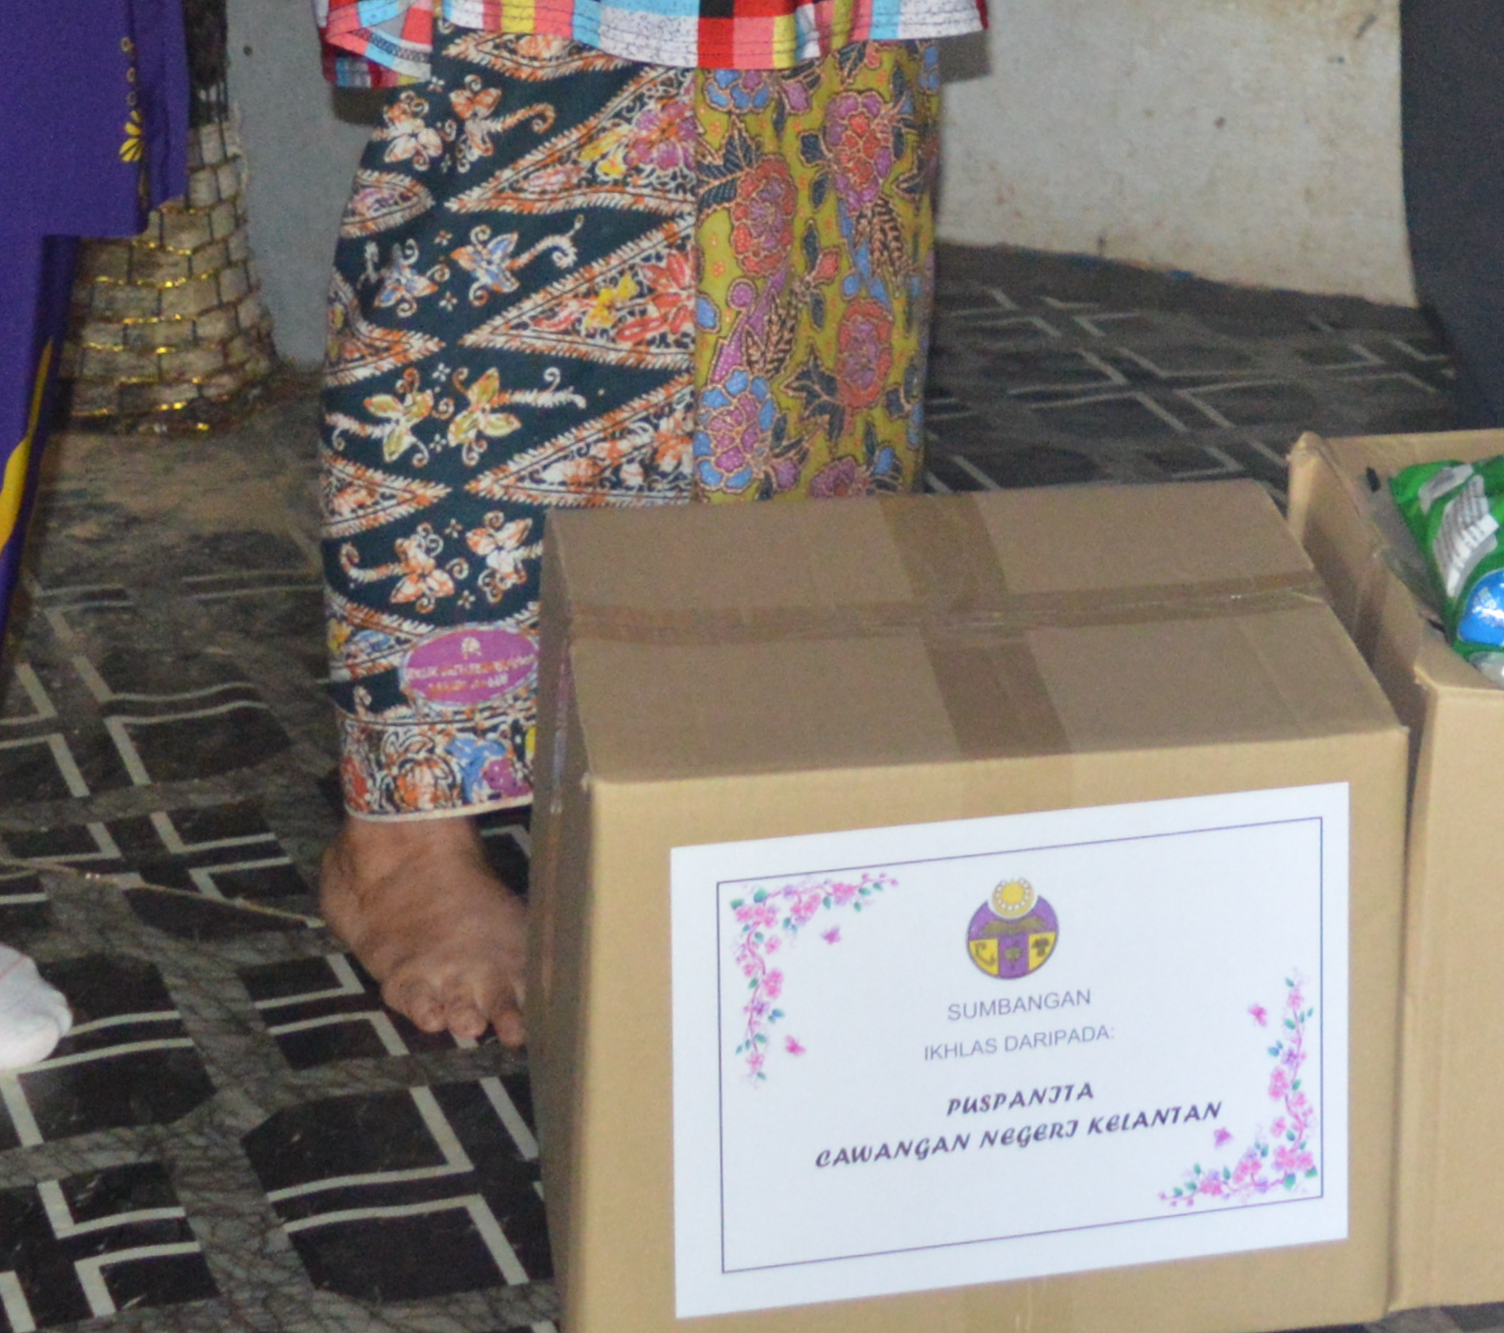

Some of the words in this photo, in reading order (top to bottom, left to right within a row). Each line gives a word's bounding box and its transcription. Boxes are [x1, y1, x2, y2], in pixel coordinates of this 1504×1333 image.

[947, 989, 1092, 1022] SUMBANGAN
[924, 1037, 998, 1061] IKHLAS
[1004, 1024, 1116, 1053] DARIPADA:
[946, 1081, 1095, 1117] PUSPANITA
[815, 1132, 971, 1169] CAWANGAN
[979, 1120, 1080, 1149] NEGERI
[1087, 1101, 1223, 1135] KELANTAN
